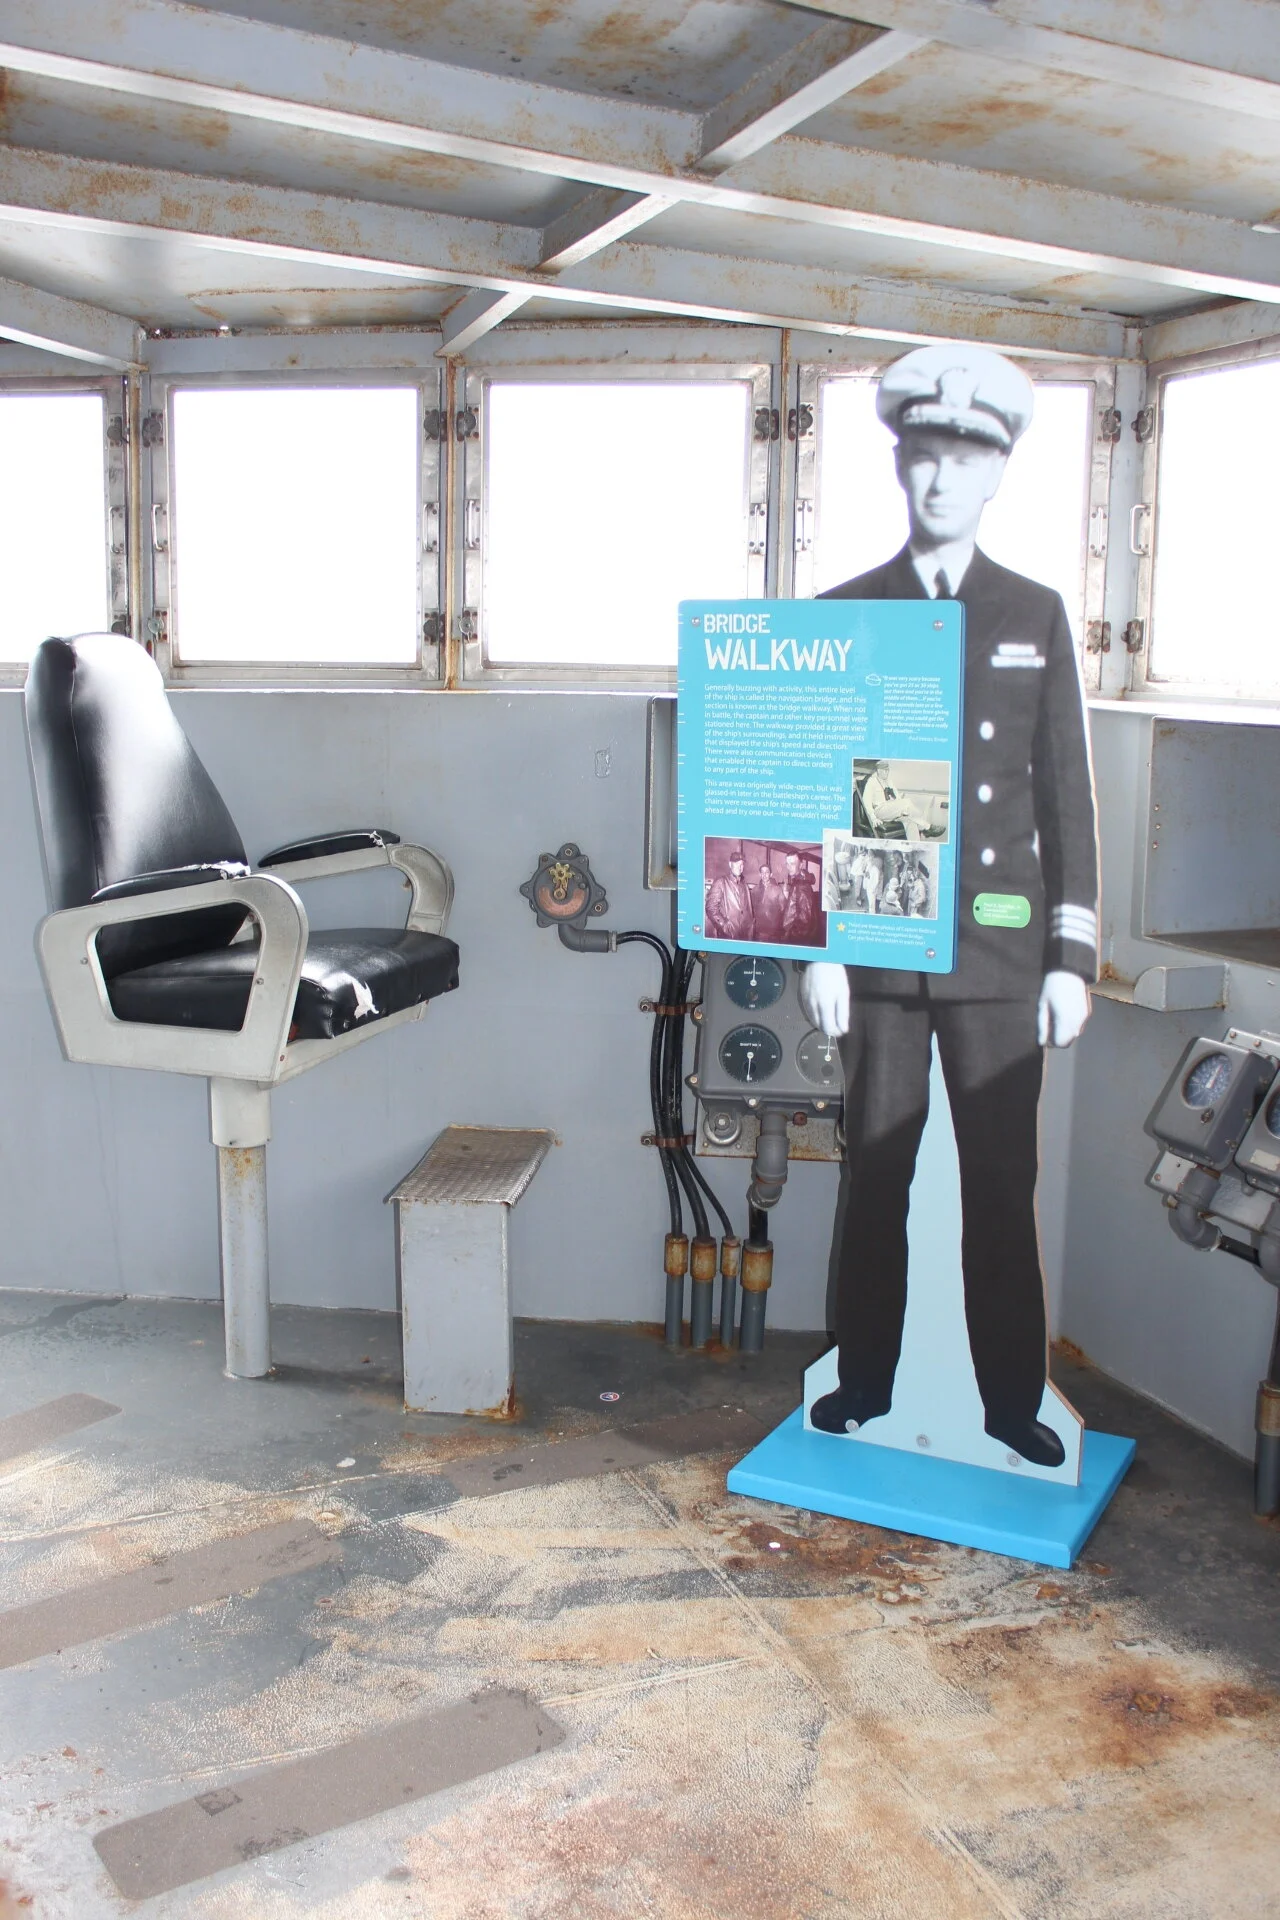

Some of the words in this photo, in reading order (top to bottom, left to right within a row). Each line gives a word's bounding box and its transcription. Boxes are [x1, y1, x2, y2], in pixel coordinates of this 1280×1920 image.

[704, 613, 771, 634] BRIDGE
[704, 638, 853, 672] WALKWAY
[704, 684, 734, 693] Generally
[735, 685, 762, 693] buzzing
[778, 685, 804, 694] activity,
[724, 694, 738, 702] ship
[778, 695, 813, 704] navigation
[814, 696, 838, 704] bridge,
[779, 704, 801, 713] bridge
[802, 705, 832, 714] walkway.
[745, 712, 769, 721] captain
[803, 714, 815, 723] key
[816, 714, 850, 724] personnel
[766, 722, 793, 731] walkway
[795, 723, 825, 732] provided
[831, 724, 849, 733] great
[724, 730, 742, 739] ship's
[743, 731, 787, 740] surroundings,
[718, 739, 749, 748] displayed
[762, 741, 780, 750] ship's
[781, 741, 801, 750] speed
[755, 750, 805, 758] communication
[758, 759, 782, 768] captain
[725, 767, 738, 775] part
[760, 768, 773, 776] ship.
[747, 782, 777, 791] originally
[778, 783, 815, 792] wide-open,
[704, 789, 736, 799] glassed-in
[773, 792, 809, 802] battleship's
[792, 802, 818, 811] captain,
[738, 809, 747, 817] try
